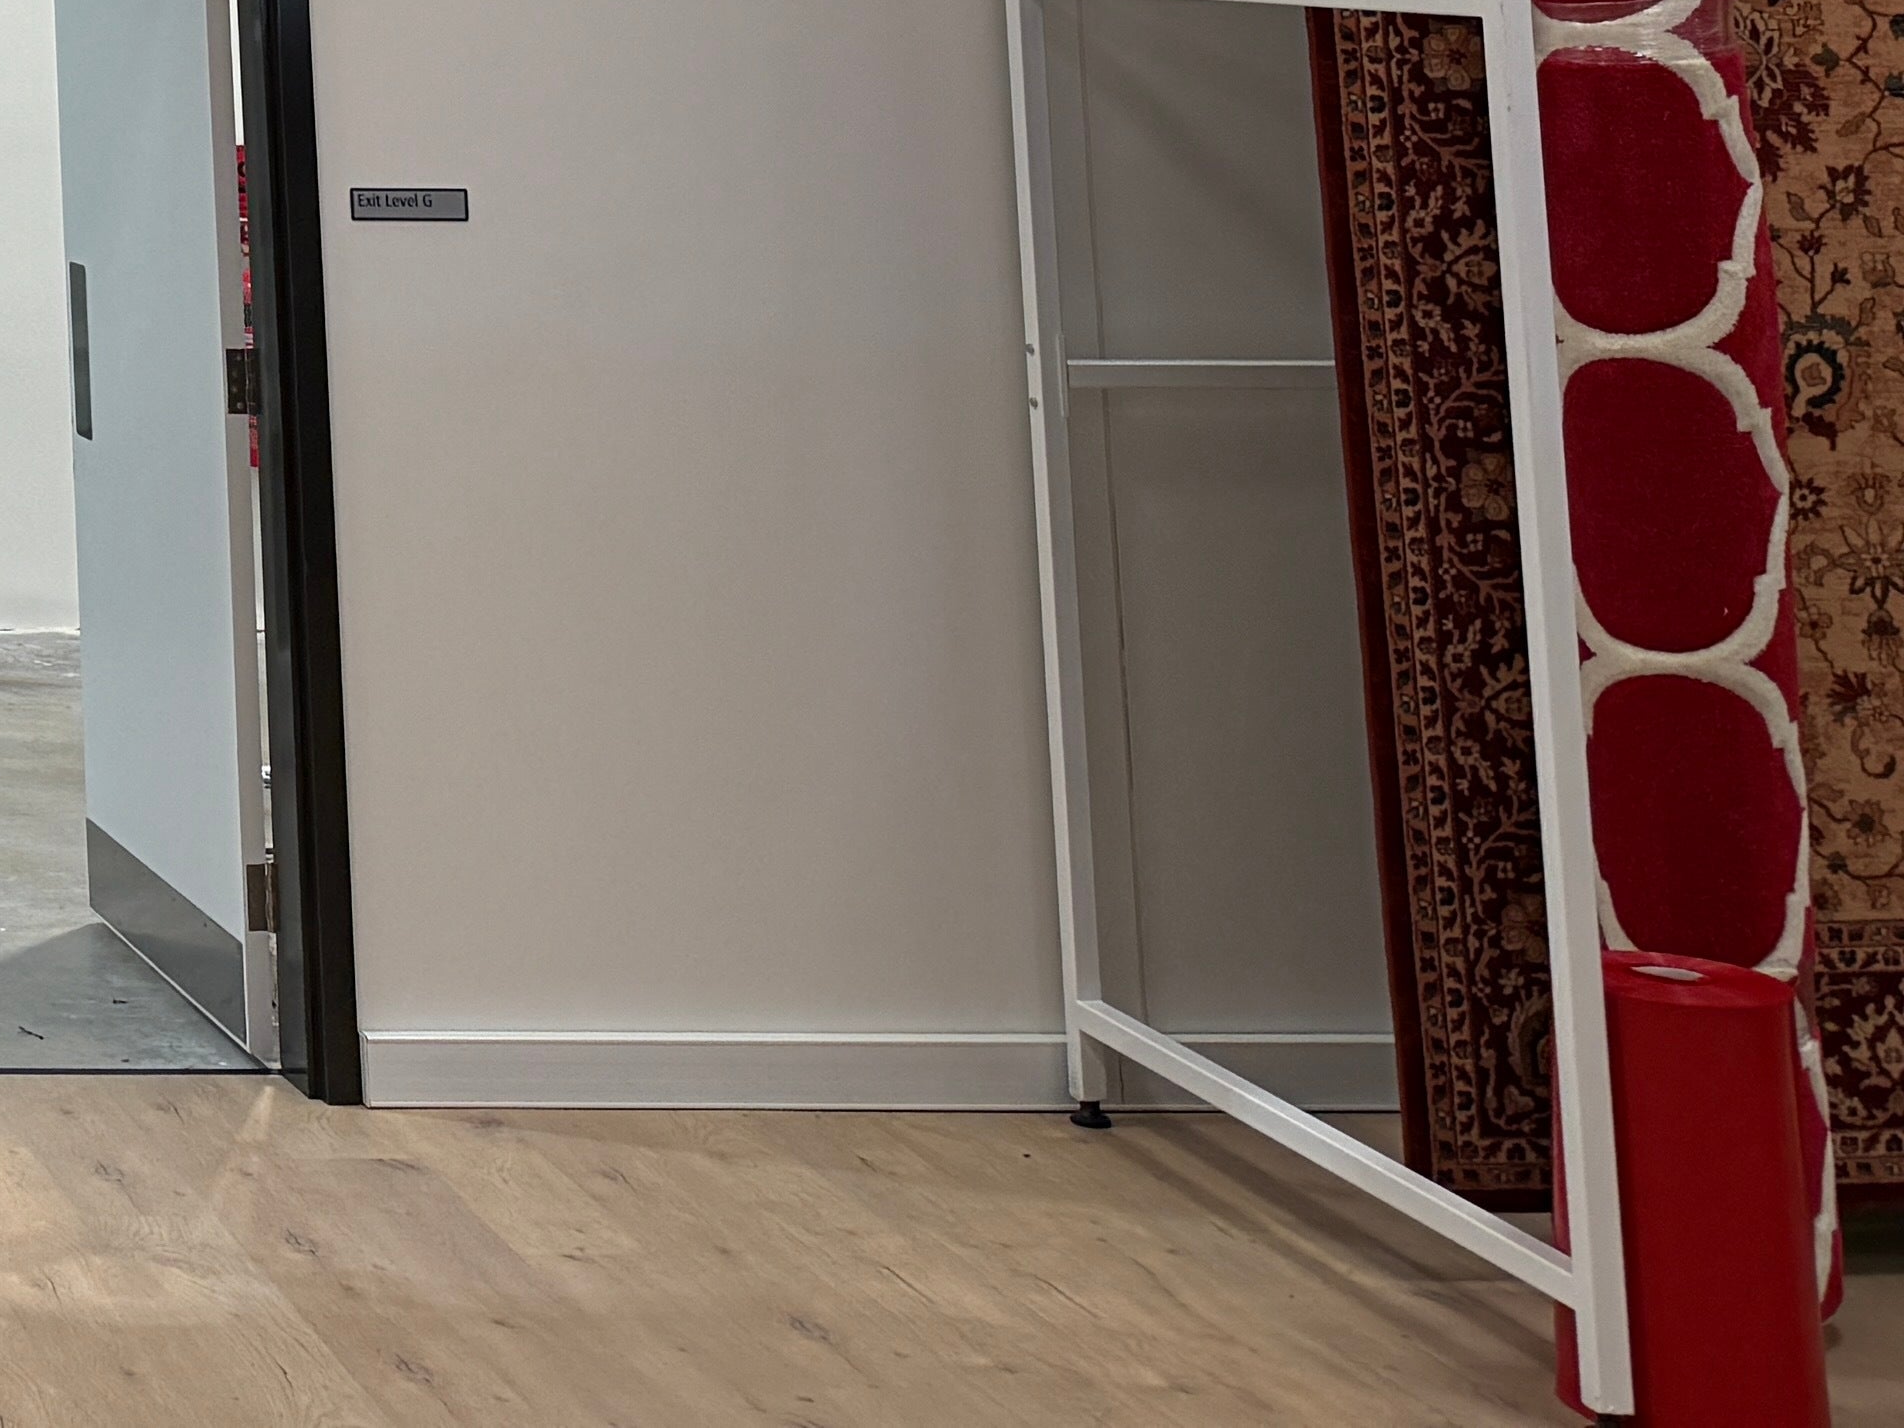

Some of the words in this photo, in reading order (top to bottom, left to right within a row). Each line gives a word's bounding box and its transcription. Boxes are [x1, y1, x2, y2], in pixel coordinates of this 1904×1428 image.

[357, 193, 381, 208] Exit
[385, 193, 418, 209] Level
[422, 194, 434, 208] G
